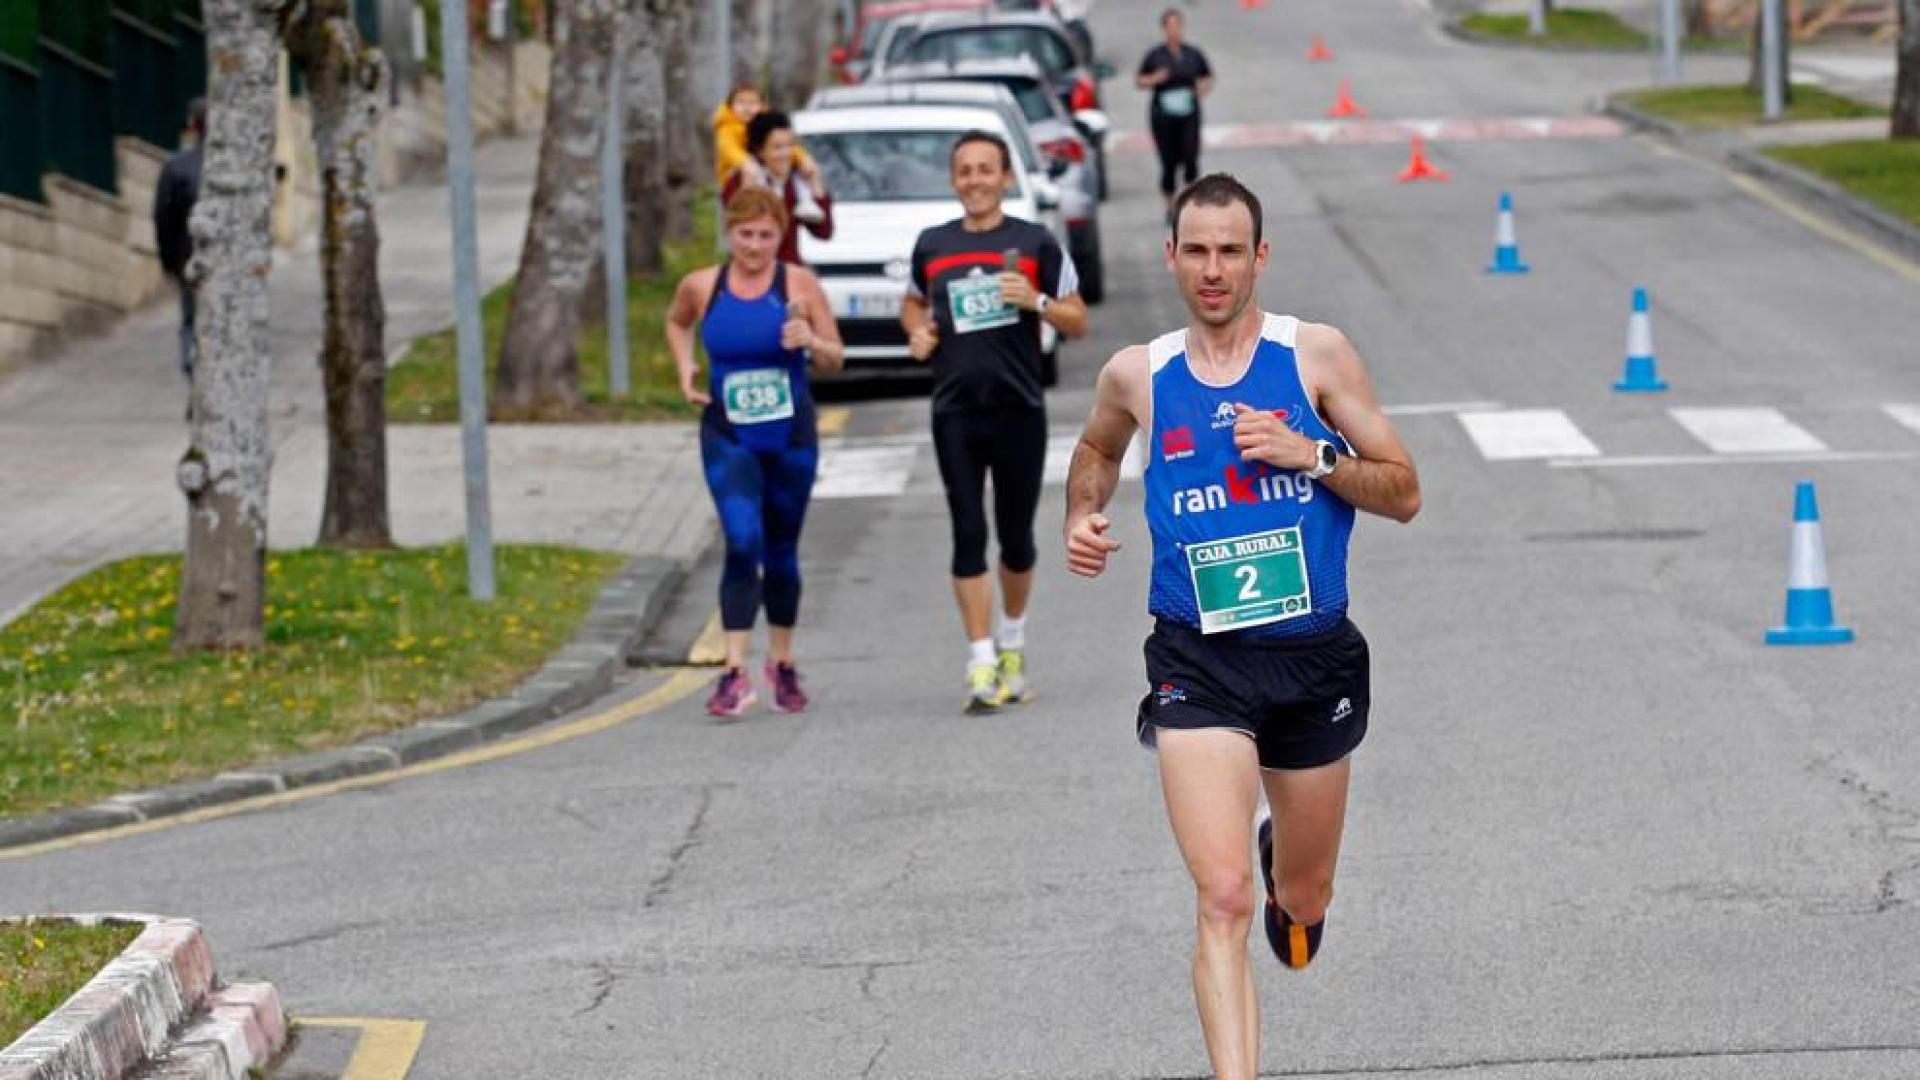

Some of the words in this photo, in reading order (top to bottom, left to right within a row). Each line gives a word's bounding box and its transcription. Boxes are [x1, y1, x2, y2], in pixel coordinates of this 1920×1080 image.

[737, 386, 778, 409] 638
[1172, 465, 1314, 515] ranking
[1196, 544, 1233, 562] CAJA
[1235, 534, 1293, 556] RURAL
[1234, 565, 1261, 600] 2
